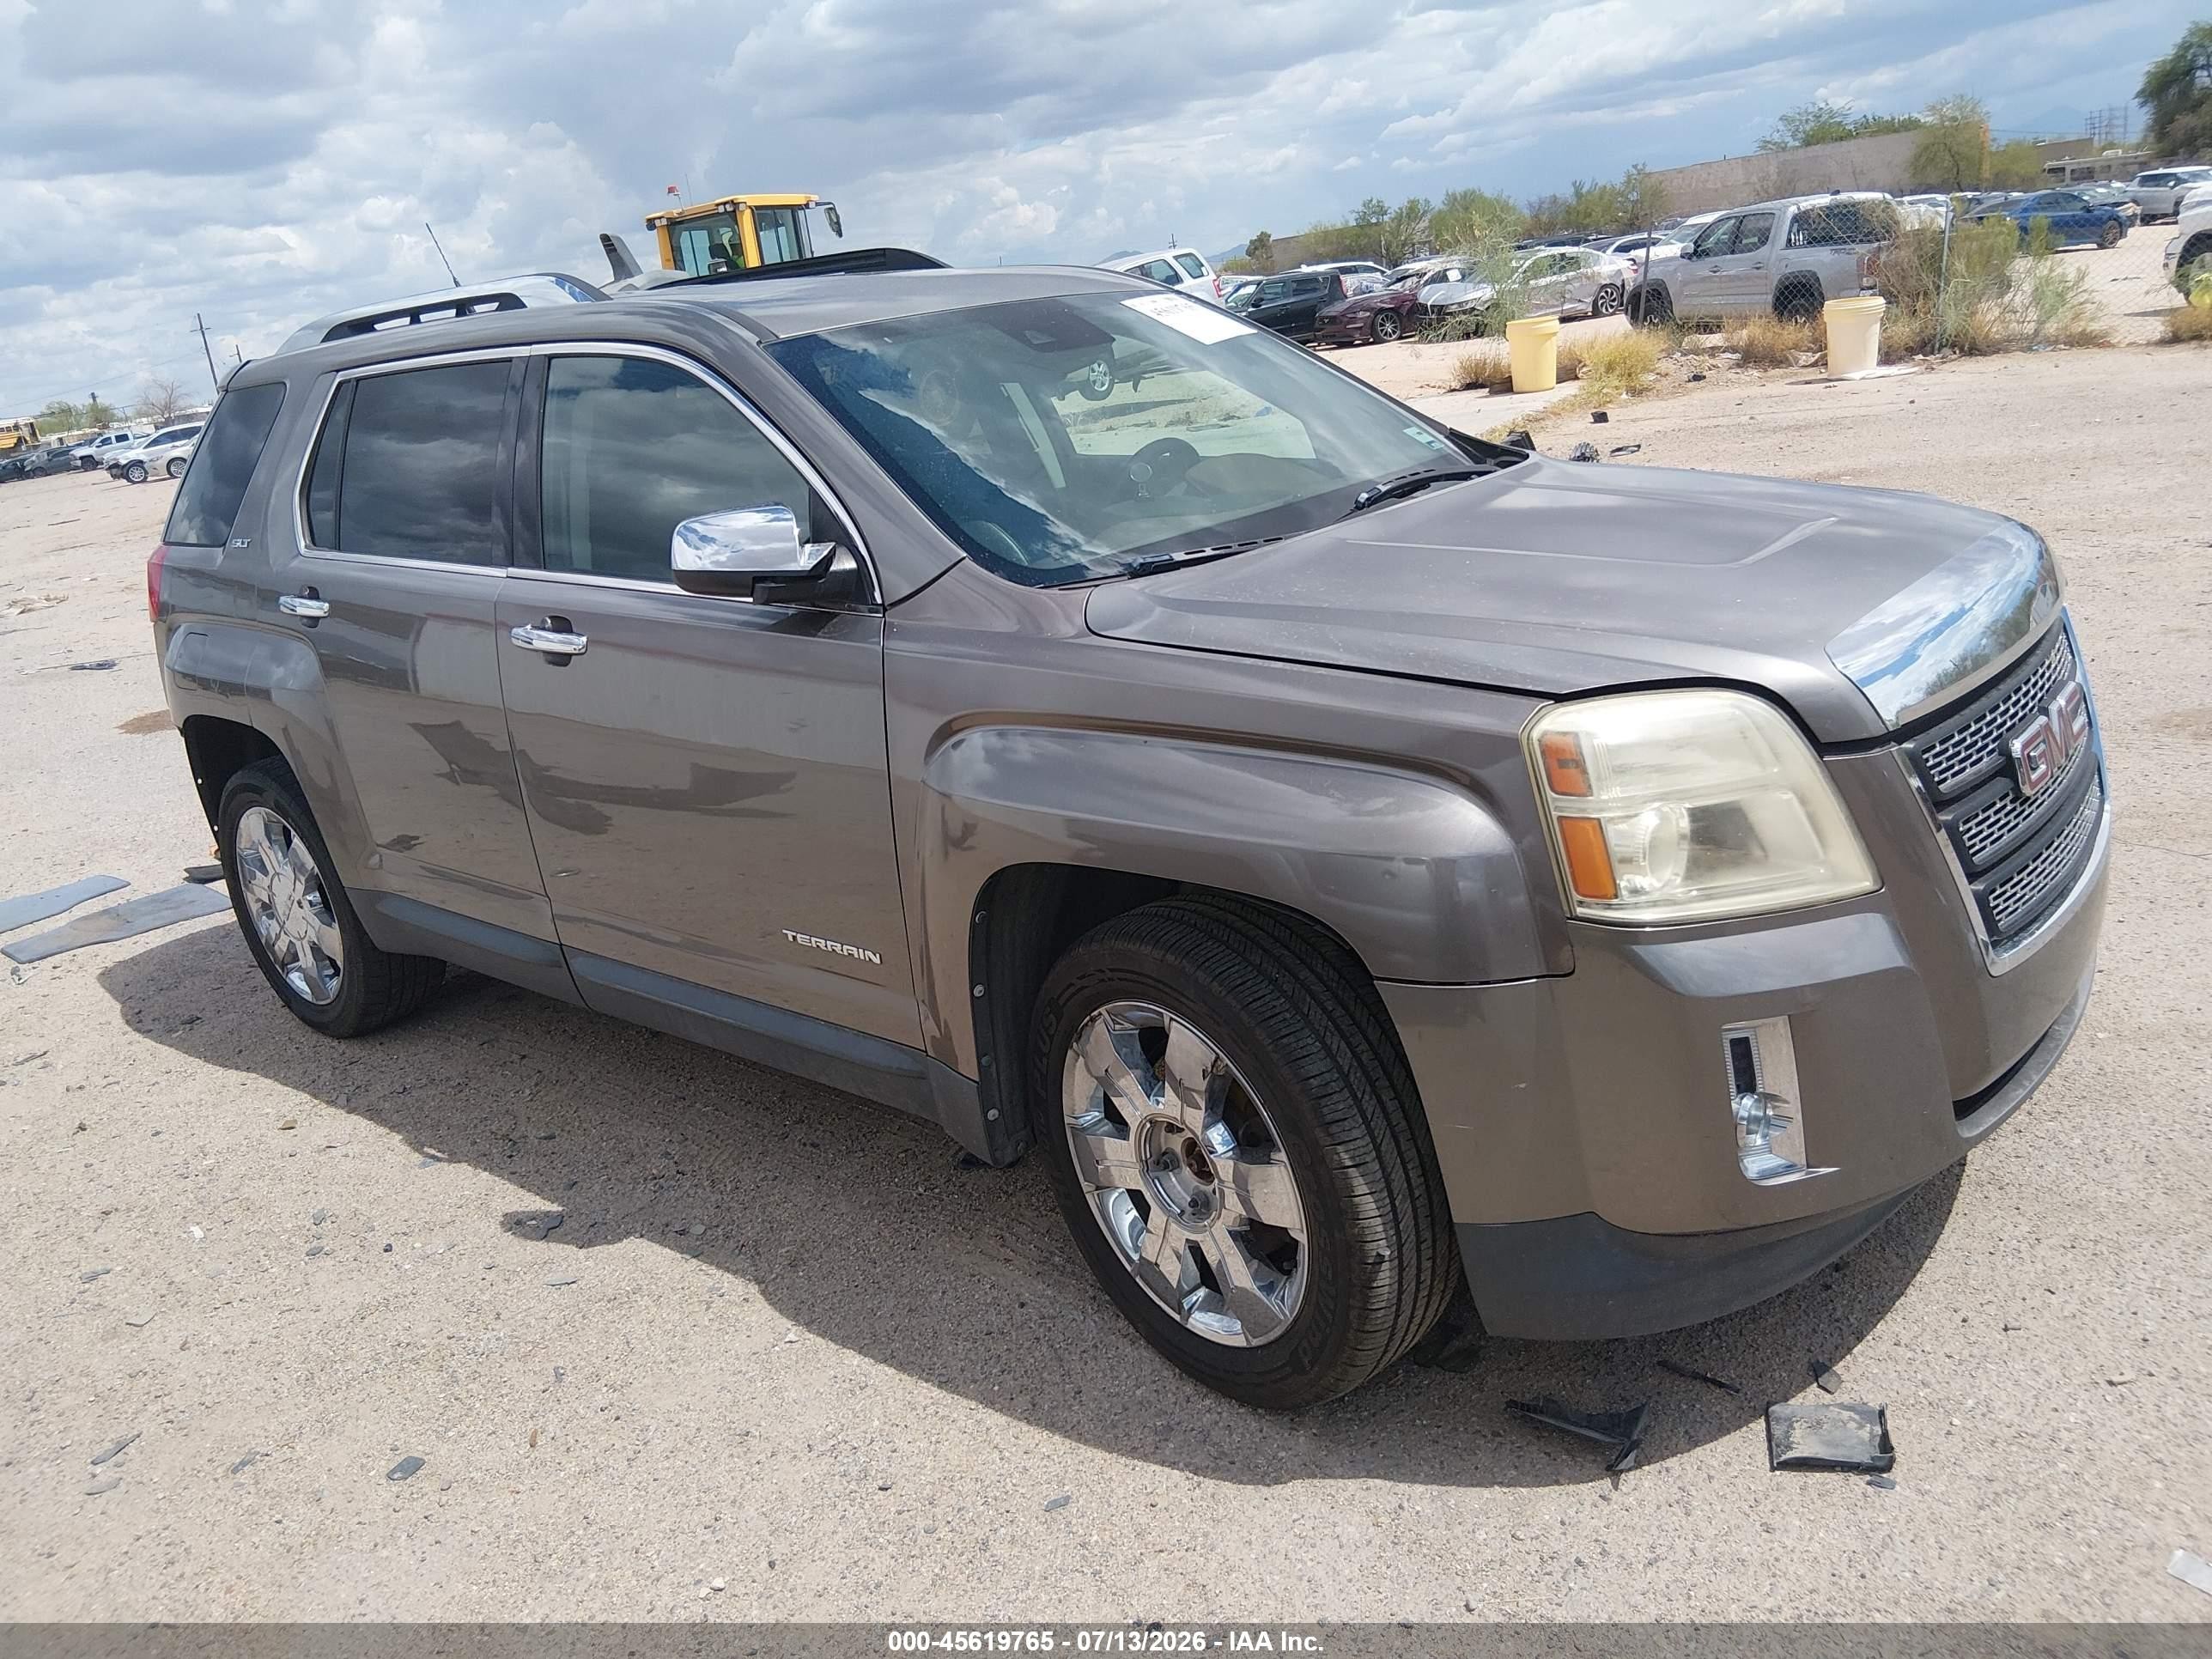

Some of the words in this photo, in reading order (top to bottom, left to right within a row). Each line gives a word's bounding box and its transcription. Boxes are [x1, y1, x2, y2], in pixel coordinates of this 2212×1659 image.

[232, 538, 252, 548] SLT
[2009, 680, 2089, 796] GMC
[781, 929, 882, 964] TERRAIN
